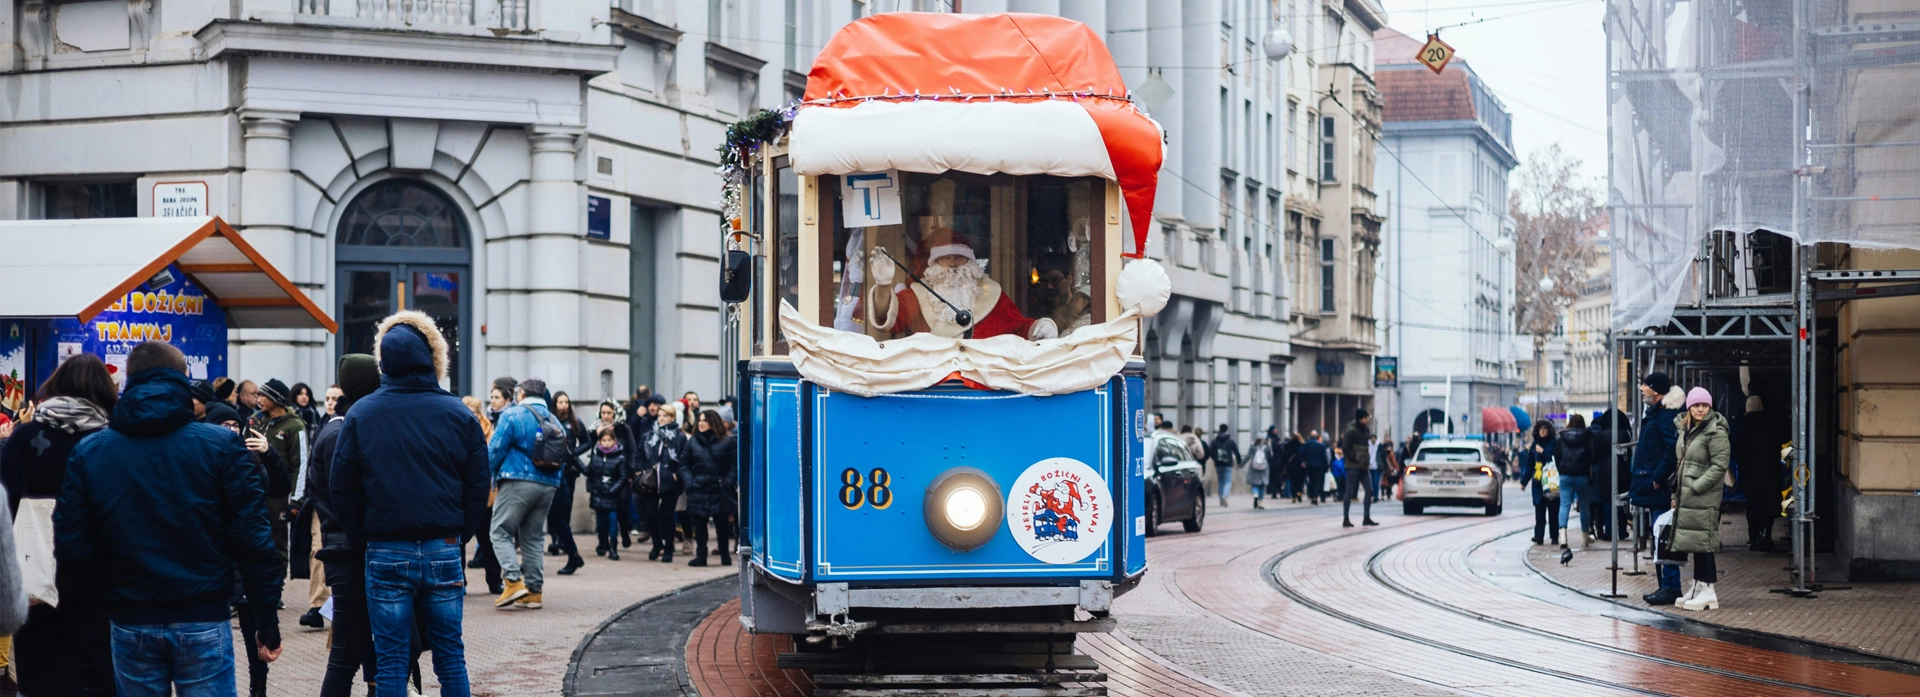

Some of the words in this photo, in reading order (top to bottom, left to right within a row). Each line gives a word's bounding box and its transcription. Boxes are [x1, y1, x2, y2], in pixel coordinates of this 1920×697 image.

[1427, 47, 1445, 62] 20
[846, 173, 892, 220] T
[96, 320, 172, 343] TRAMVAJ
[839, 467, 893, 510] 88
[1022, 494, 1032, 531] VESELI
[1083, 483, 1099, 533] TRAMVAJ
